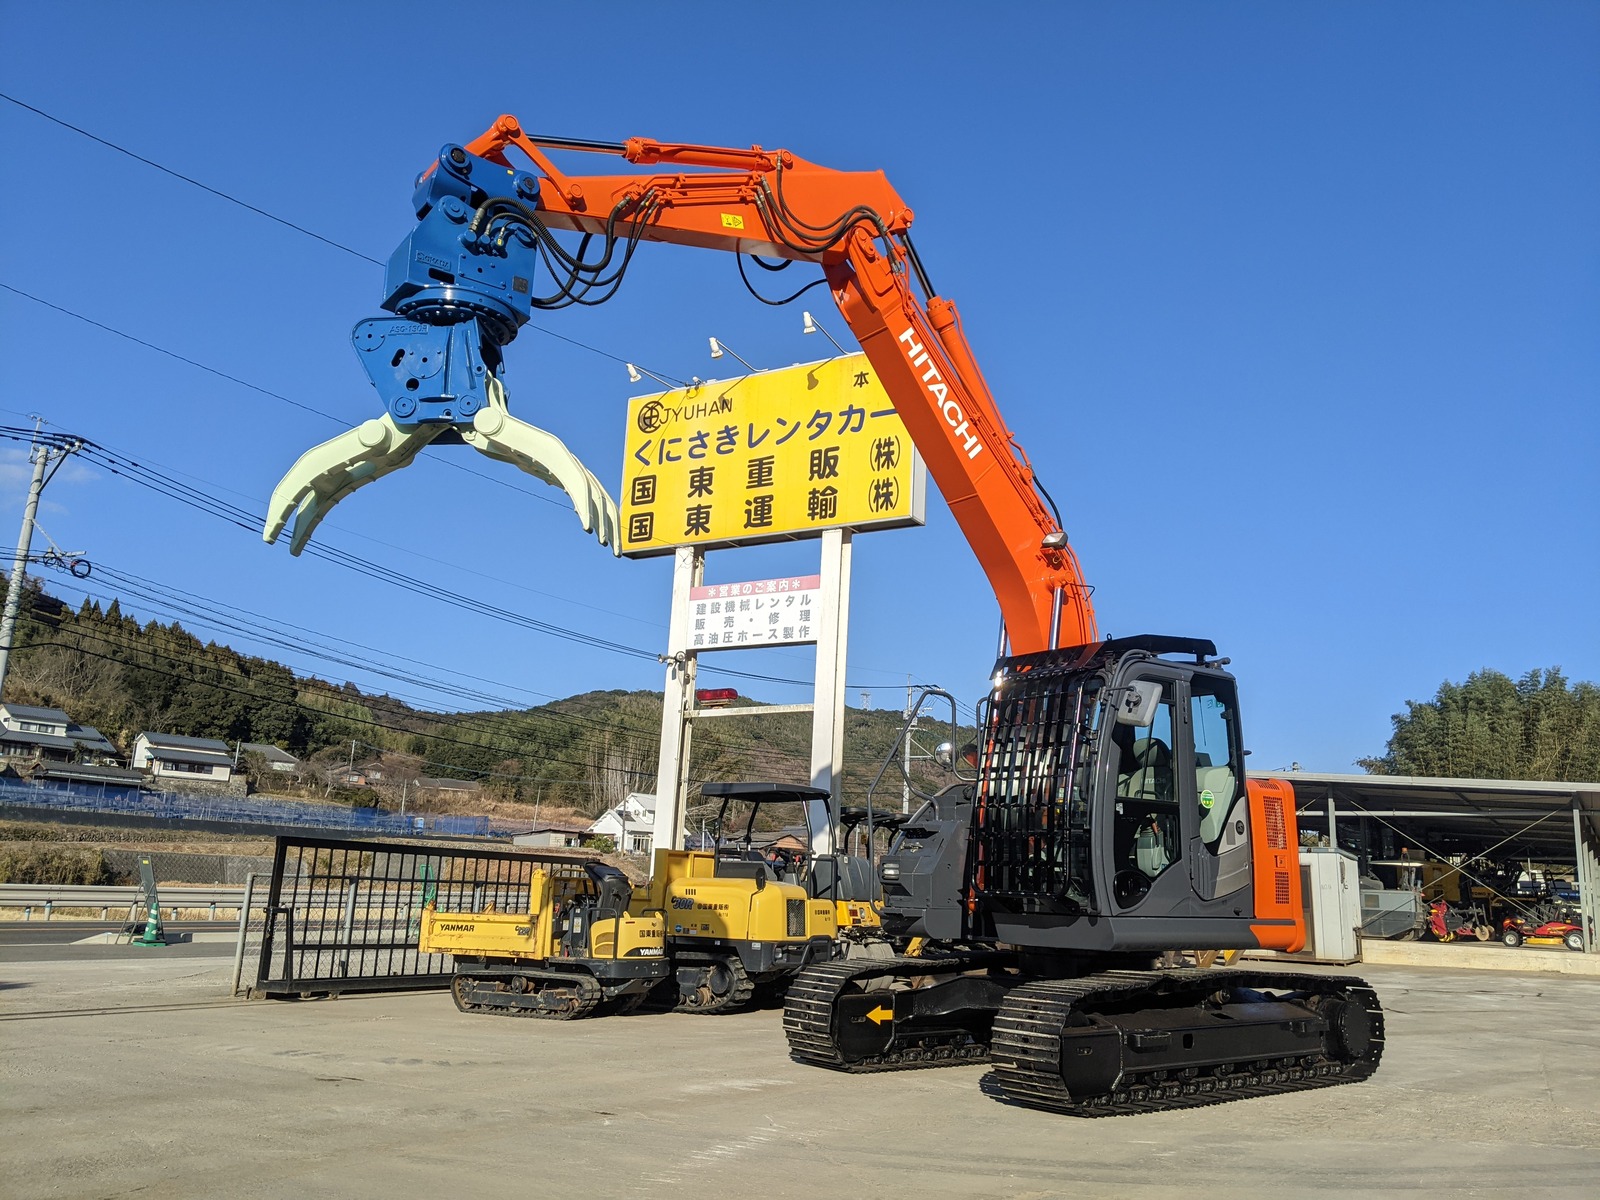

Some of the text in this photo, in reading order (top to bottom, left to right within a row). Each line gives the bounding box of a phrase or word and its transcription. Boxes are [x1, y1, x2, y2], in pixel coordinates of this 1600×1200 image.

[899, 327, 983, 460] HITACHI
[659, 397, 733, 425] JYUHAN
[634, 404, 898, 466] くにさきレンタカー
[696, 594, 812, 616] 建設機械レンタル
[694, 625, 810, 646] 高油圧ホース製作
[440, 924, 475, 932] YANMAR
